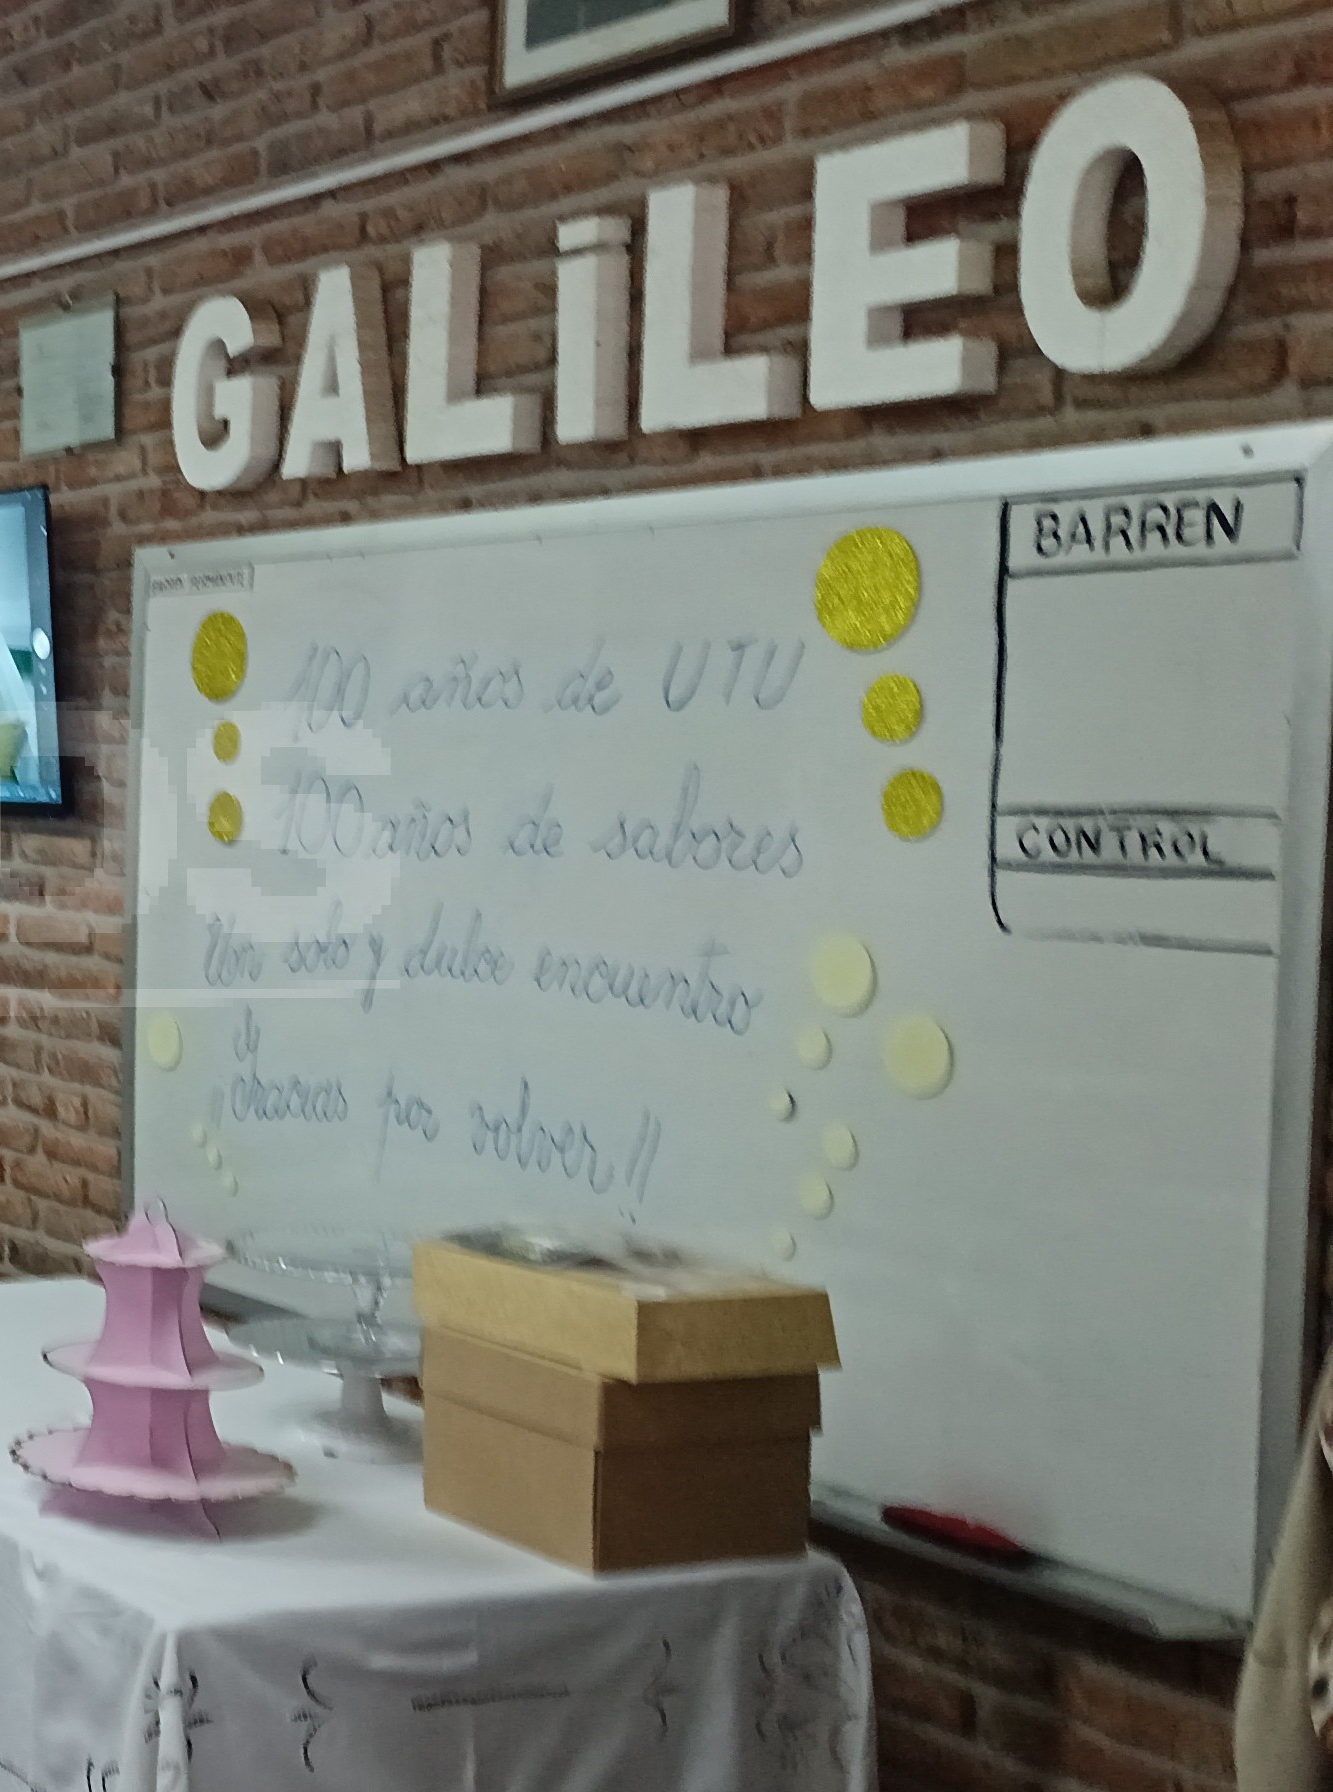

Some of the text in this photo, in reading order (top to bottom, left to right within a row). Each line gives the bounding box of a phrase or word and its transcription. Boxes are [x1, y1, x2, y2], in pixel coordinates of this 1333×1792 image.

[1034, 497, 1244, 558] BARREN
[285, 636, 806, 742] 100 años de UTU
[276, 760, 805, 878] 100 años de sabores
[1016, 820, 1225, 867] CONTROL
[284, 897, 352, 974] solo
[360, 931, 386, 1014] y
[403, 900, 516, 986] dulce
[533, 938, 764, 1036] encuentro
[376, 1066, 441, 1184] por
